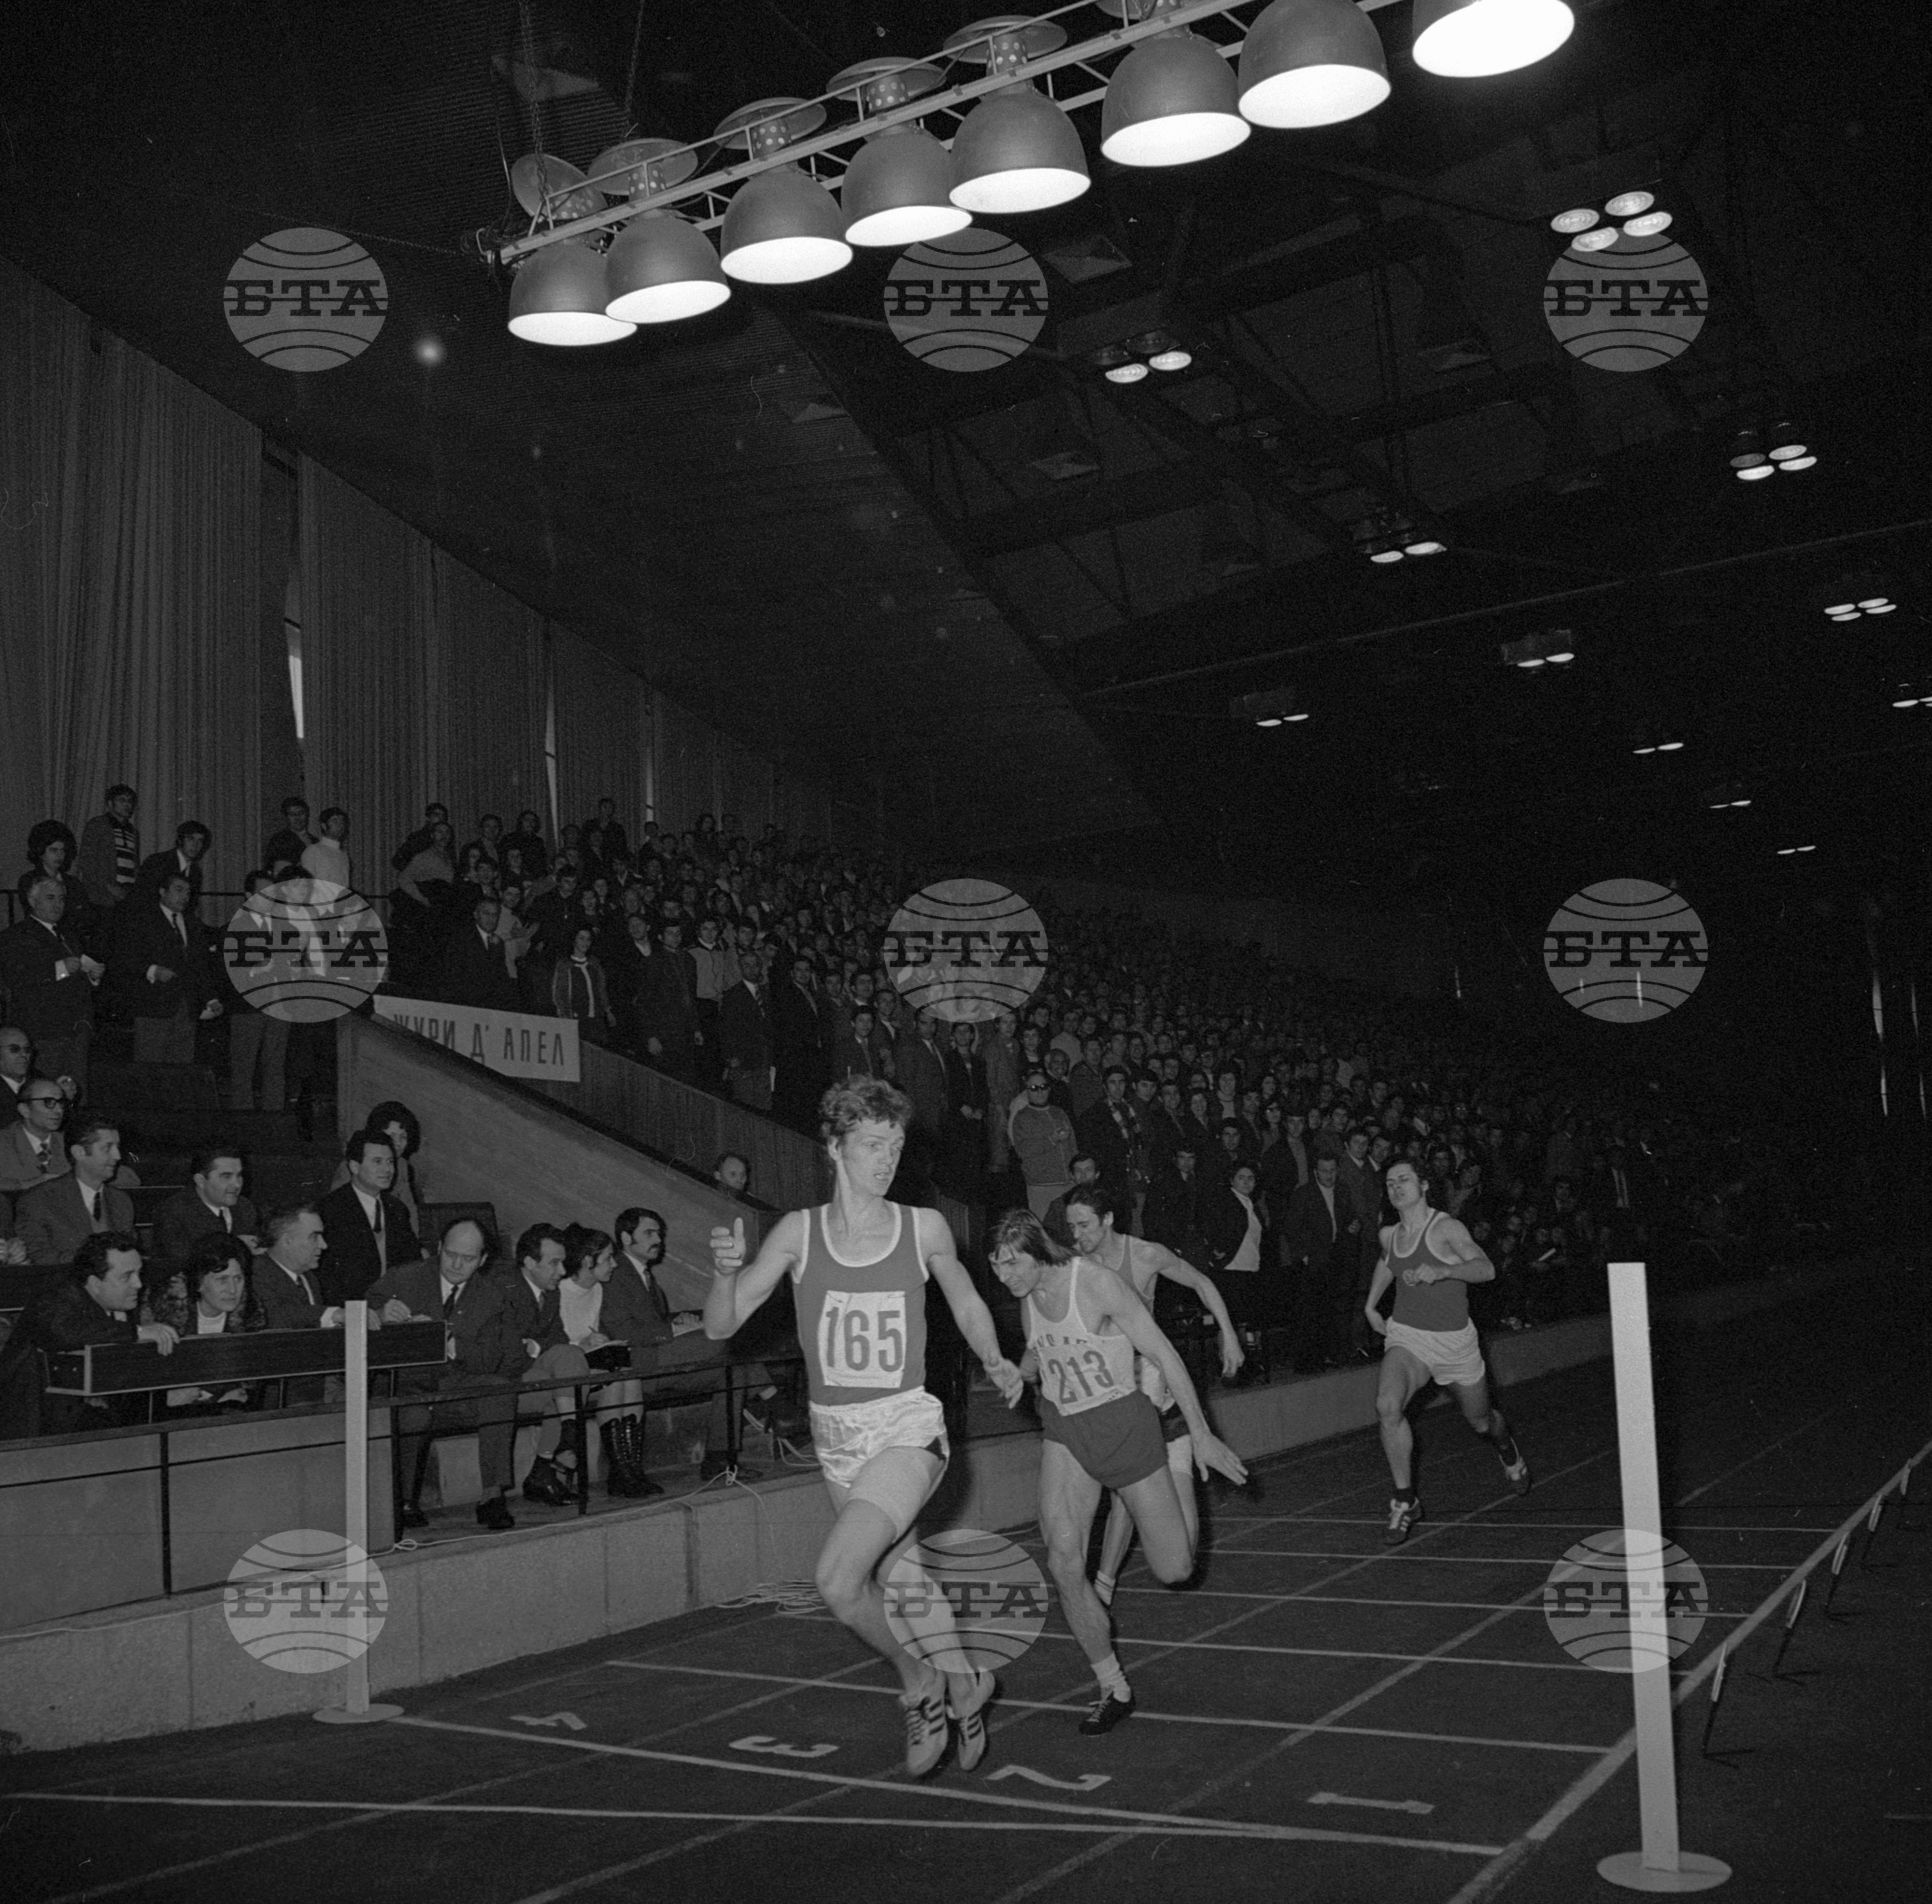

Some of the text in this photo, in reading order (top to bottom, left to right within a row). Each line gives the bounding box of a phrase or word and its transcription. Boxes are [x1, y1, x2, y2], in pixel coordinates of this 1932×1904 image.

[826, 1307, 903, 1372] 165
[1048, 1350, 1114, 1404] 213
[510, 1711, 587, 1730] 4
[729, 1735, 839, 1757] 3
[985, 1764, 1112, 1790] 2
[1307, 1791, 1435, 1815] 1
